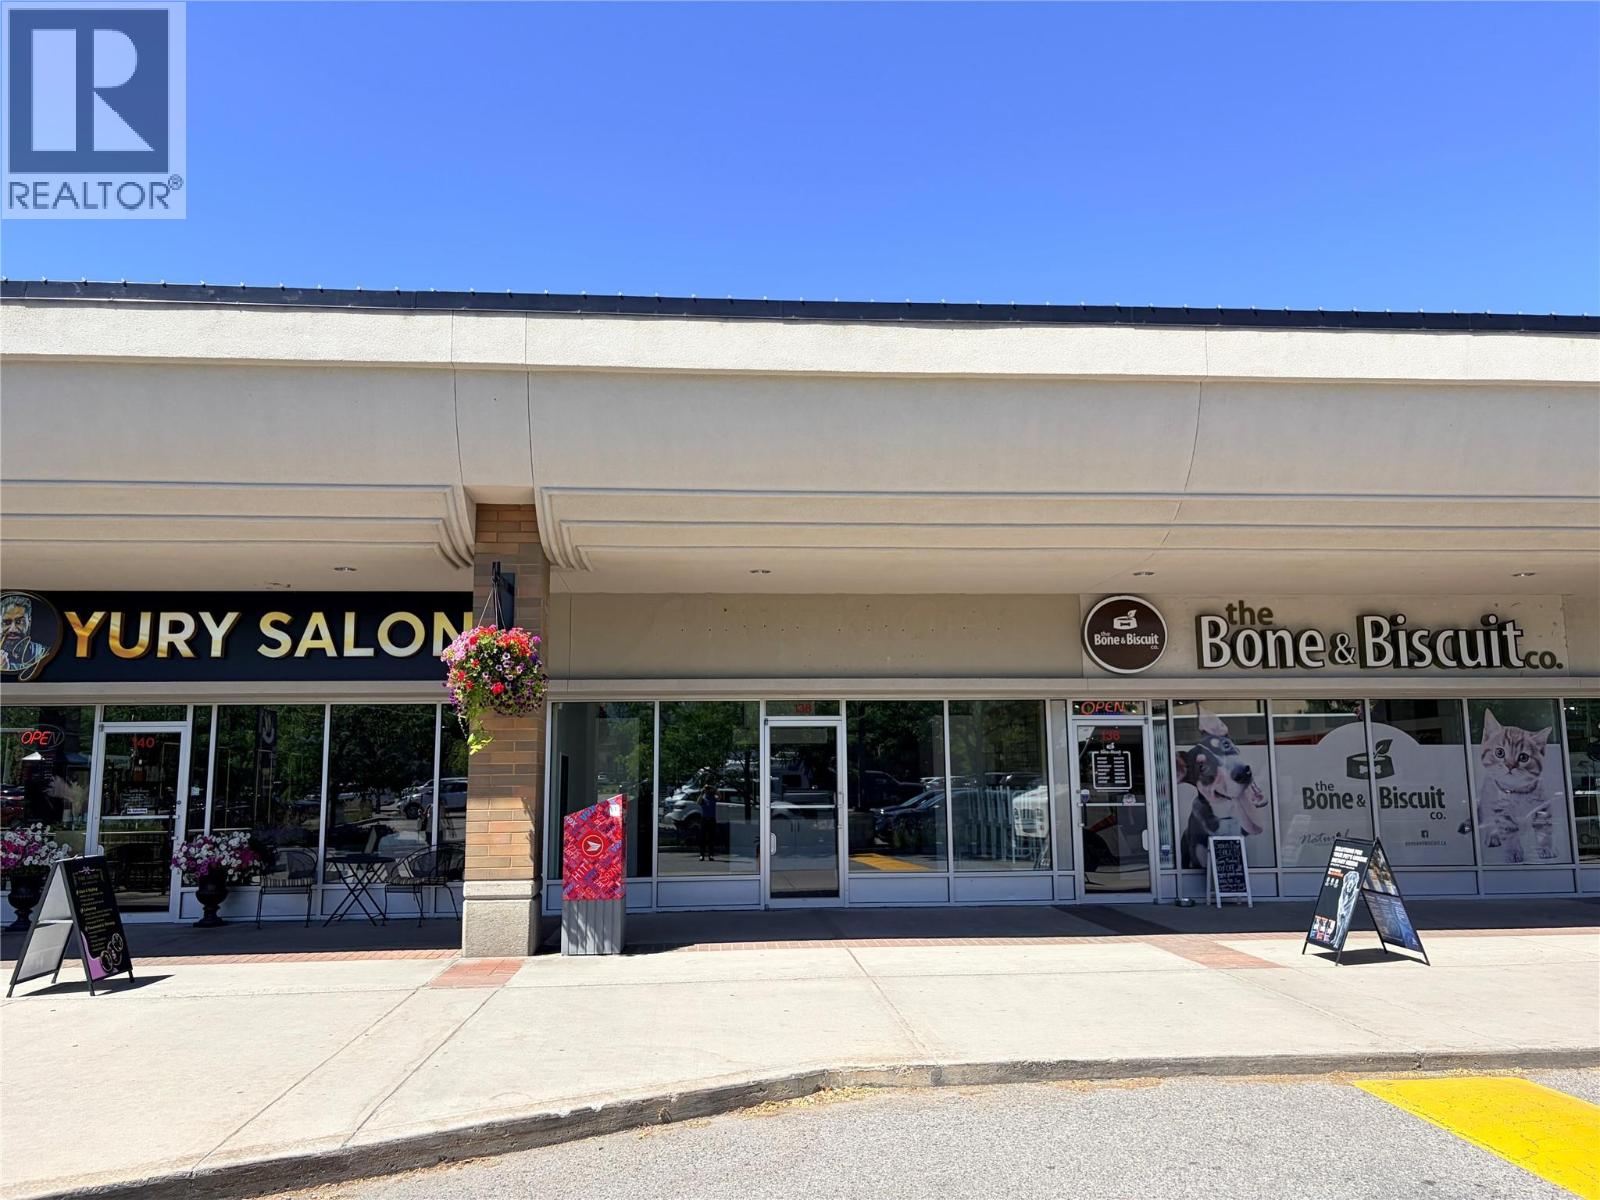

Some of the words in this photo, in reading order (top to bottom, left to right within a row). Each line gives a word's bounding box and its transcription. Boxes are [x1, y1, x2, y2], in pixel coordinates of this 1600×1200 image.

[1225, 600, 1274, 626] the
[64, 611, 241, 659] YURY
[256, 610, 473, 659] SALON
[1094, 633, 1120, 646] Bone
[1120, 637, 1126, 645] &
[1126, 633, 1160, 645] Biscuit
[1196, 614, 1327, 669] Bone
[1331, 632, 1358, 665] &
[1358, 613, 1525, 669] Biscuit
[1080, 700, 1125, 716] OPEN
[20, 730, 60, 746] OPEN
[131, 736, 156, 749] 140
[1315, 780, 1335, 792] the
[1302, 786, 1354, 810] Bone
[1356, 793, 1367, 808] &
[1378, 785, 1446, 810] Biscuit
